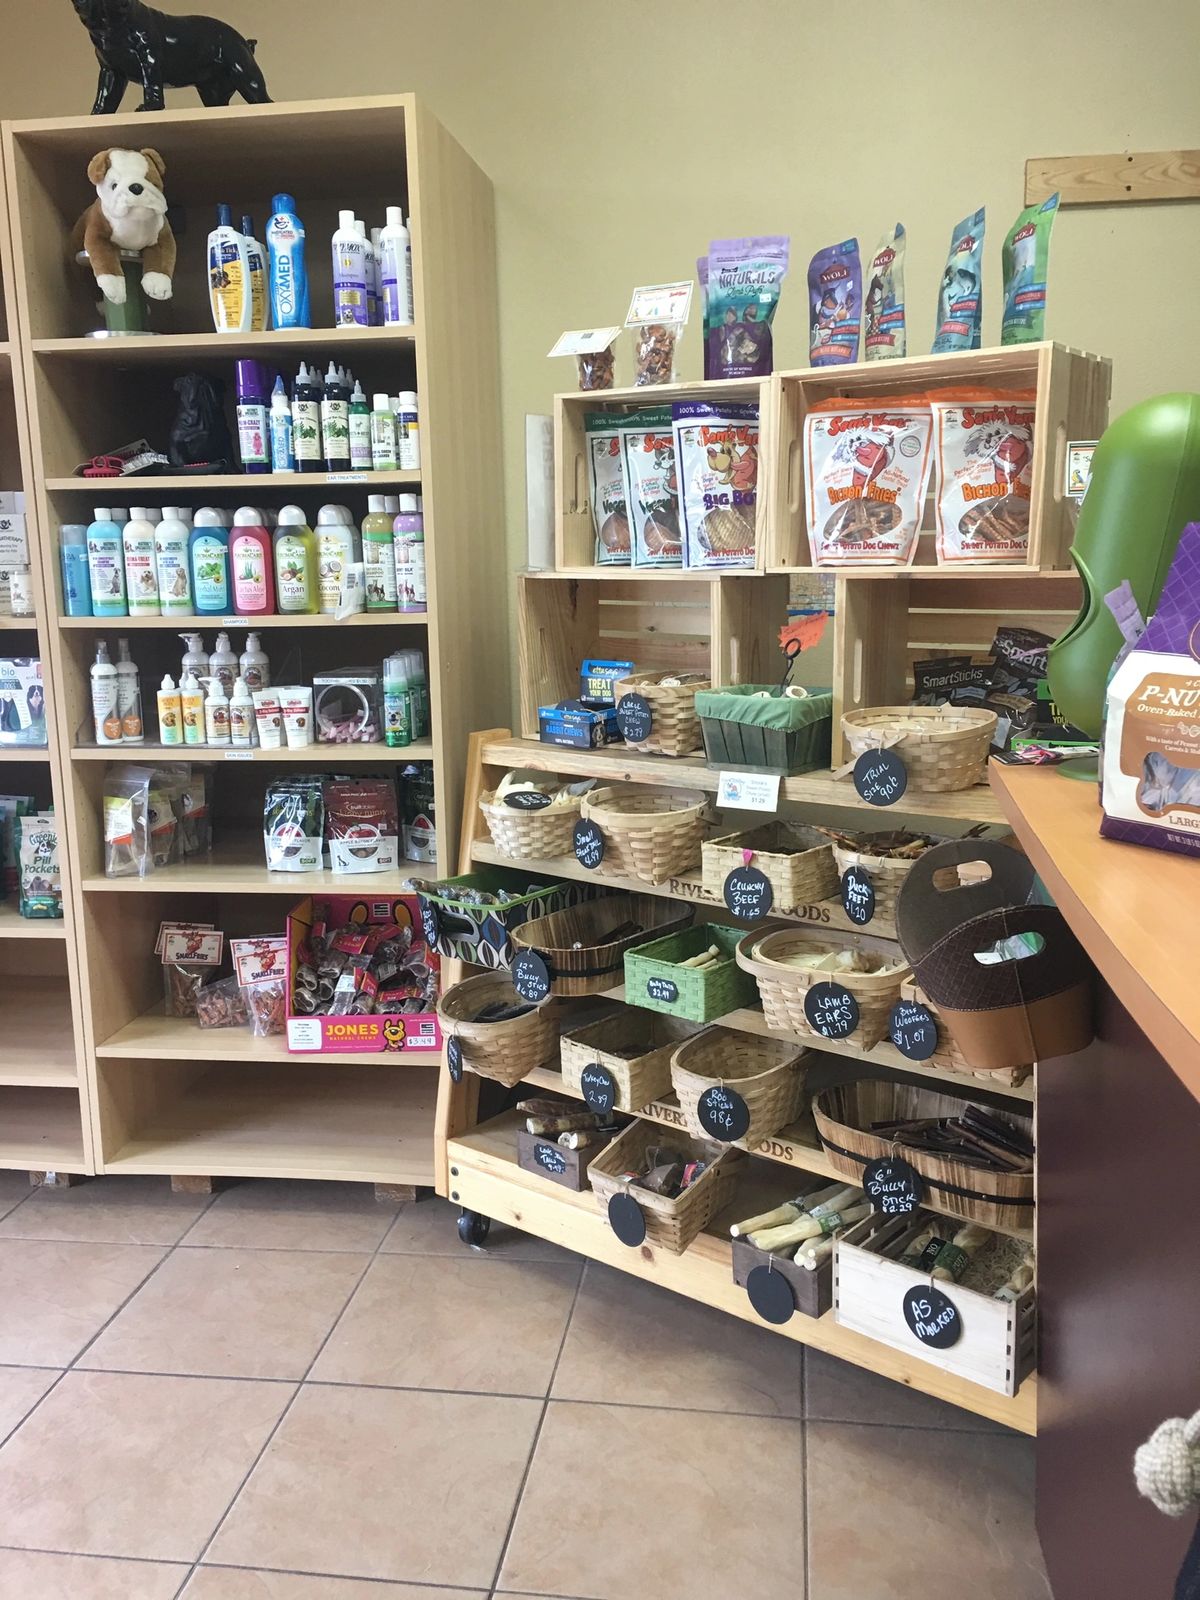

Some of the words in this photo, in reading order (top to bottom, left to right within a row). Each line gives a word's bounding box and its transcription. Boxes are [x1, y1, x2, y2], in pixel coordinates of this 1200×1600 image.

[278, 254, 293, 315] OXYMED
[719, 271, 776, 289] NATURALS
[680, 406, 695, 414] 100%
[961, 405, 1002, 430] Sam's
[1003, 405, 1036, 426] Yam
[828, 413, 872, 436] Sam's
[697, 424, 737, 447] Sam's
[961, 481, 1010, 502] BICHON
[703, 492, 730, 511] BIG
[732, 489, 758, 506] BO
[862, 541, 877, 550] DOG
[283, 586, 305, 596] Argan
[1002, 639, 1048, 672] Smart
[587, 678, 612, 691] TREAT
[923, 668, 983, 689] SmartSticks
[1138, 685, 1200, 707] P-NU
[1137, 703, 1198, 719] Oven-Baked
[545, 725, 564, 735] RABBIT
[564, 727, 584, 737] CHEWS
[862, 763, 890, 784] TRIAL
[864, 782, 881, 801] SIZE
[1168, 815, 1200, 829] LARG
[29, 831, 57, 845] Greeni
[34, 855, 52, 865] Pill
[732, 891, 760, 906] BEEF
[848, 890, 869, 905] FEET
[818, 994, 851, 1010] LAMB
[814, 1005, 853, 1025] EARS
[325, 1023, 380, 1036] JONES
[868, 1180, 907, 1196] BULLY
[882, 1192, 917, 1207] STICK
[911, 1299, 932, 1322] AS
